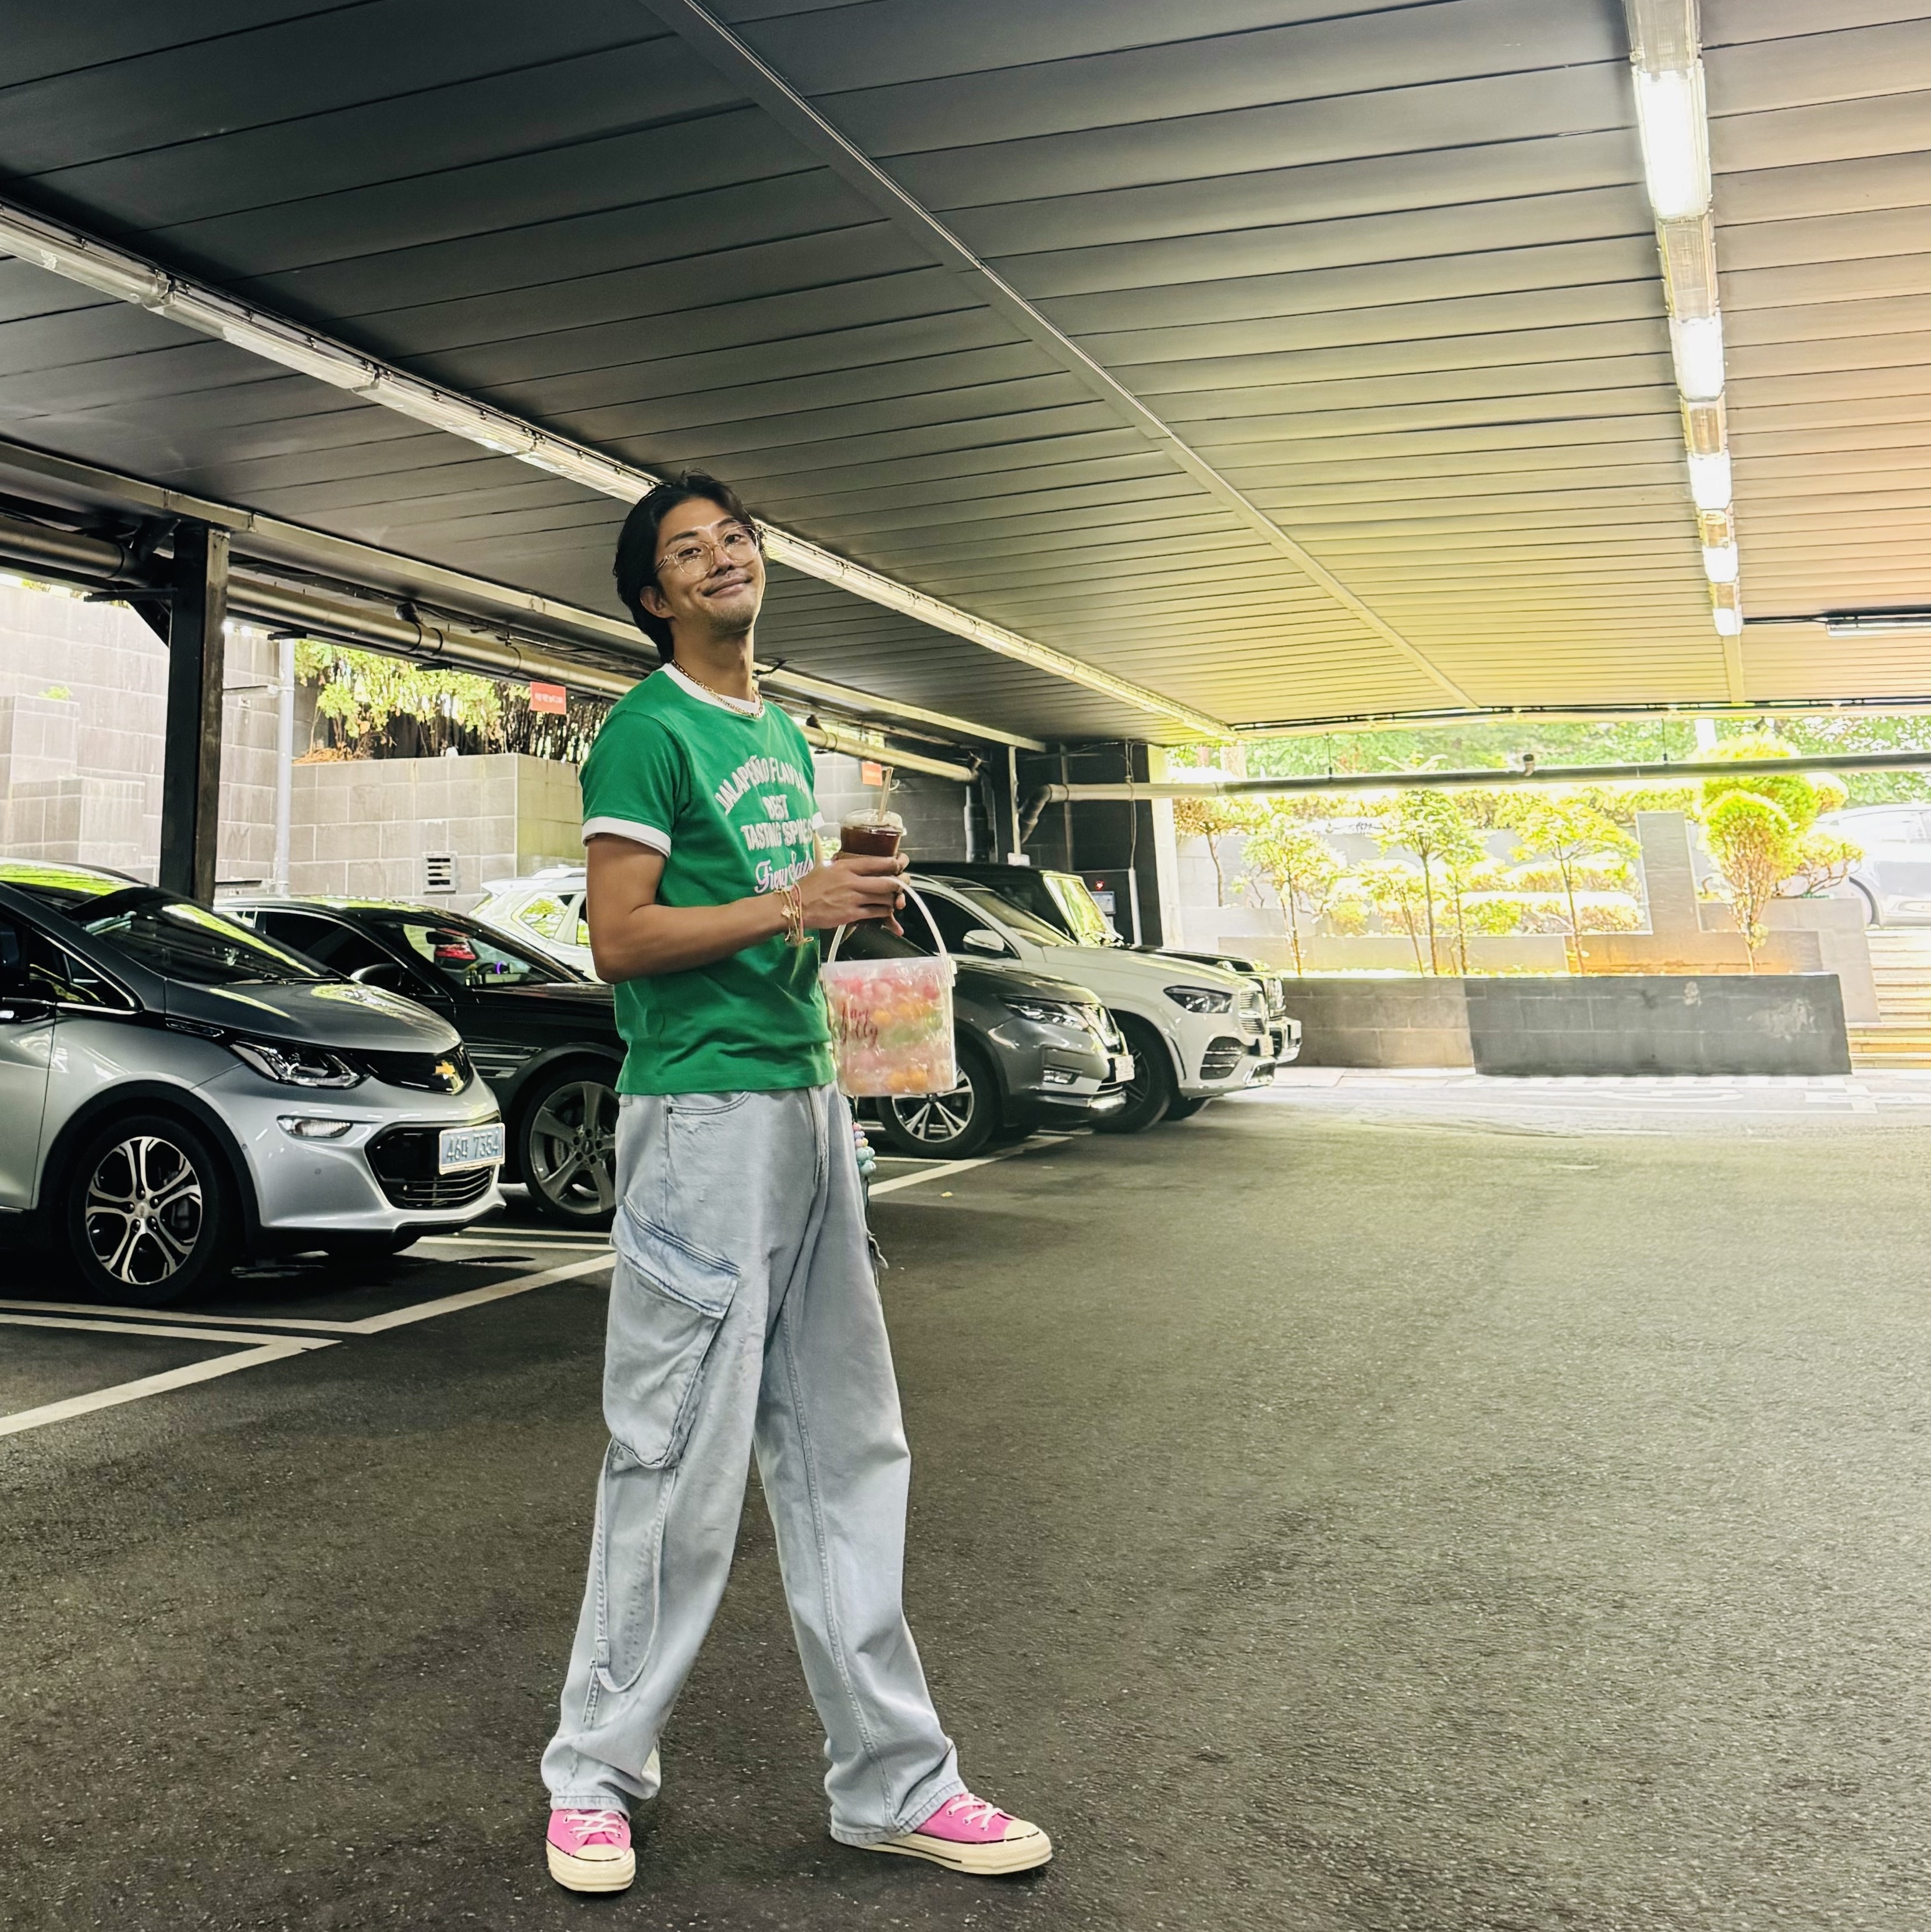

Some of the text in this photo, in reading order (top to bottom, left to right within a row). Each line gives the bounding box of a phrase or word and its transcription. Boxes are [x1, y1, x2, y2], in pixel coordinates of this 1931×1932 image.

[715, 754, 769, 815] JALAPEÑO
[762, 794, 789, 821] BEST
[740, 821, 782, 851] TASTING
